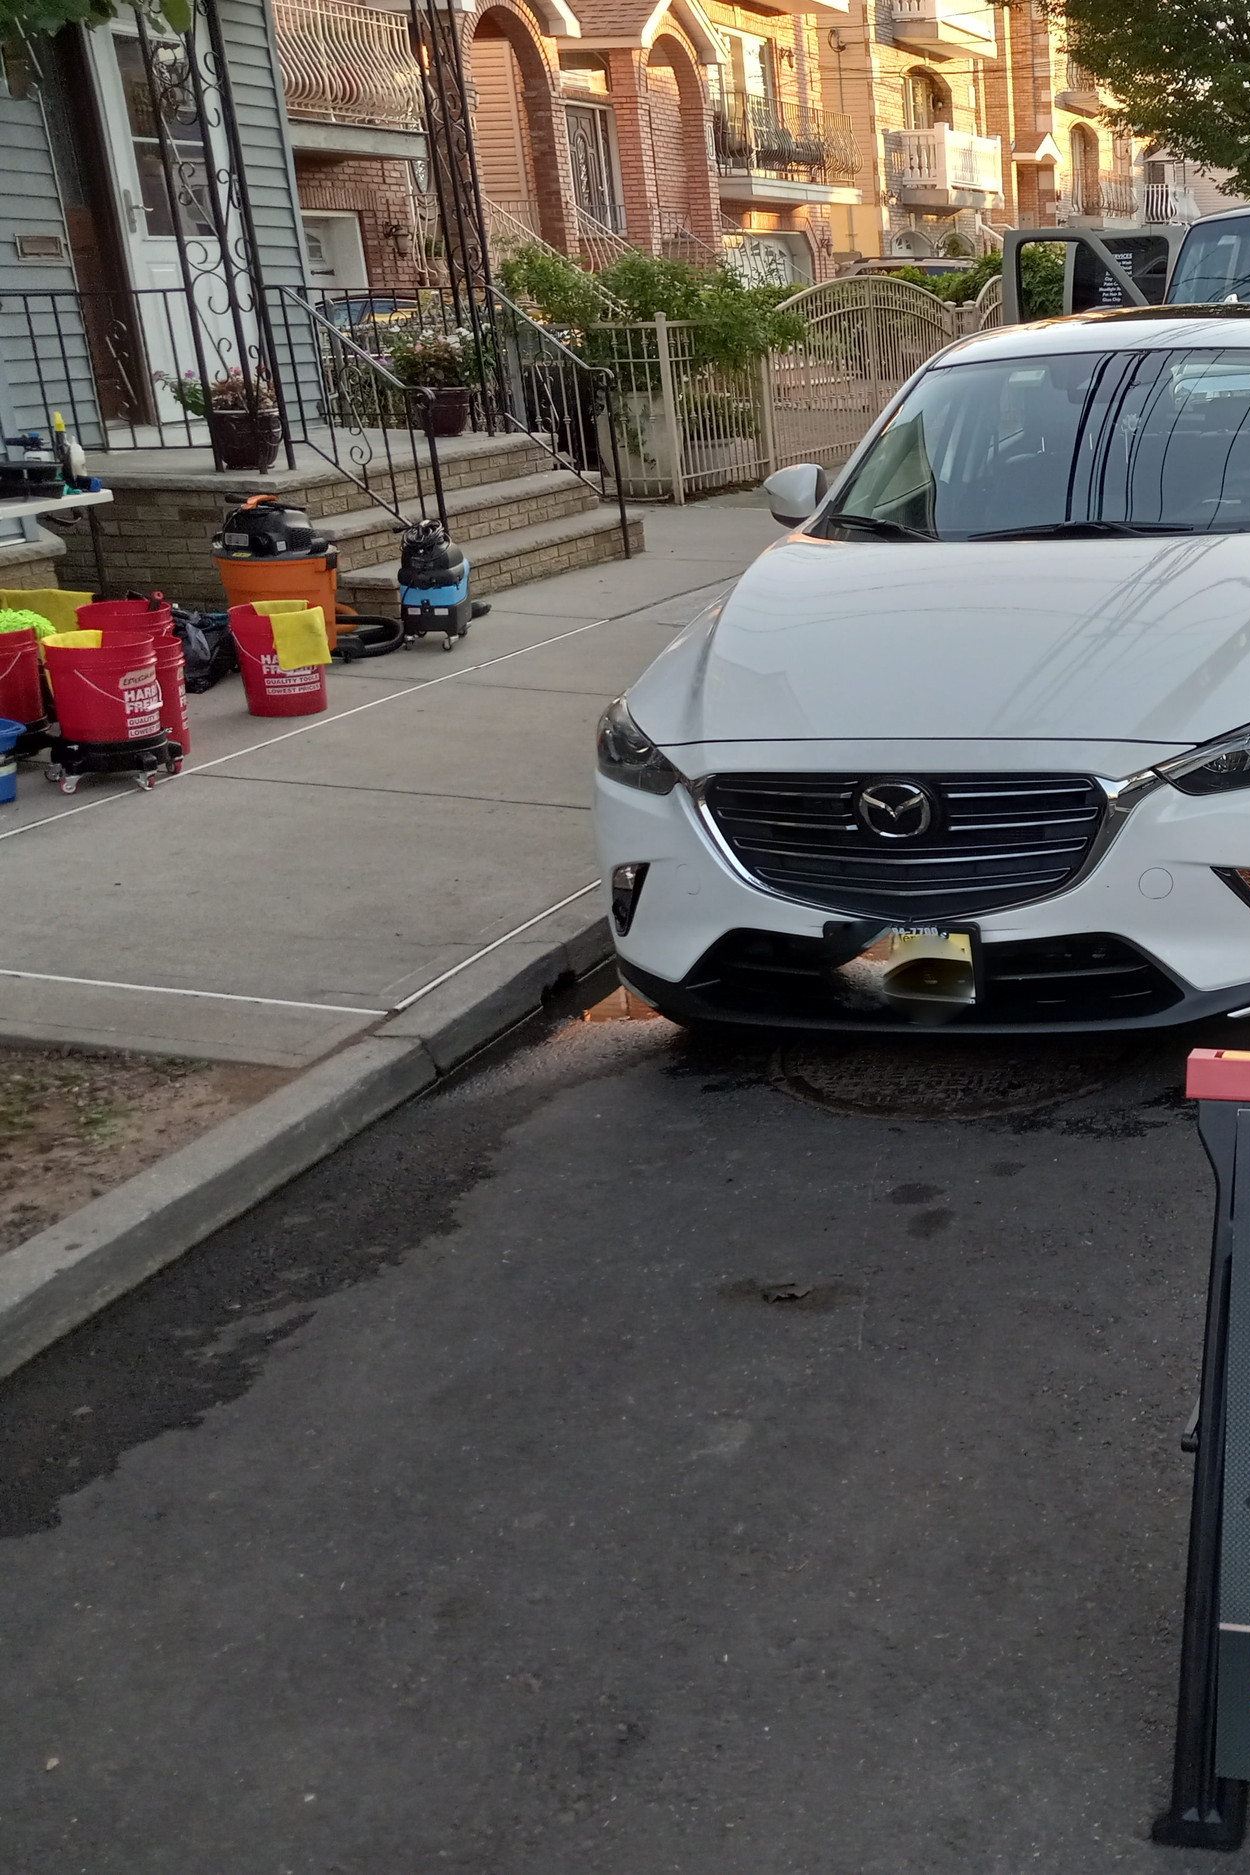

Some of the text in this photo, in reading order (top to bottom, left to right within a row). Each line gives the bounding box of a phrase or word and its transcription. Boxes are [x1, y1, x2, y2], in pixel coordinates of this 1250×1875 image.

[266, 674, 319, 685] QUALITY TOOLS
[124, 684, 158, 702] HARB
[298, 684, 320, 692] PRICES
[128, 714, 155, 725] QUALITY
[130, 726, 155, 737] LOWEST
